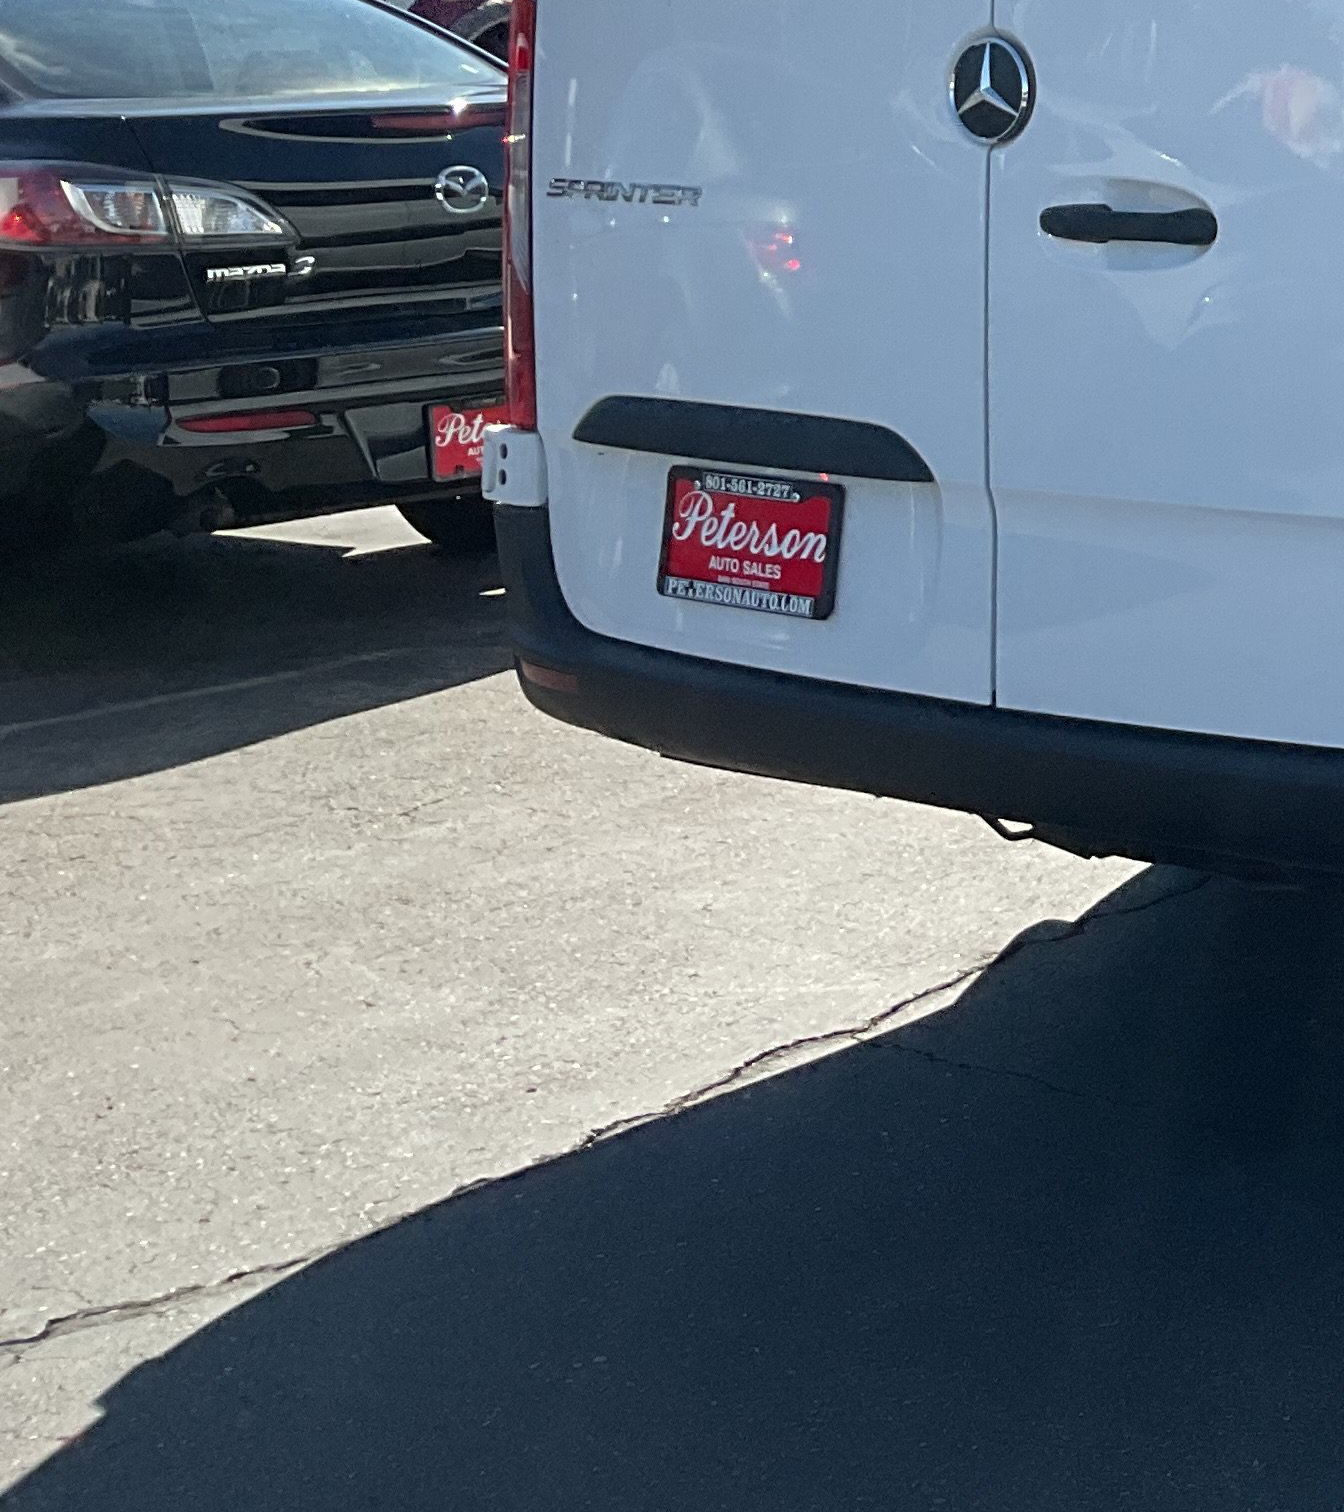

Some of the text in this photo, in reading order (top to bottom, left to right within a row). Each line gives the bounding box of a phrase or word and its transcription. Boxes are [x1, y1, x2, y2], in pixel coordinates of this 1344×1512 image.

[546, 177, 703, 207] SPRINTER
[705, 473, 792, 501] 801-561-2727
[672, 490, 827, 564] Peterson
[708, 555, 781, 580] AUTO SALES
